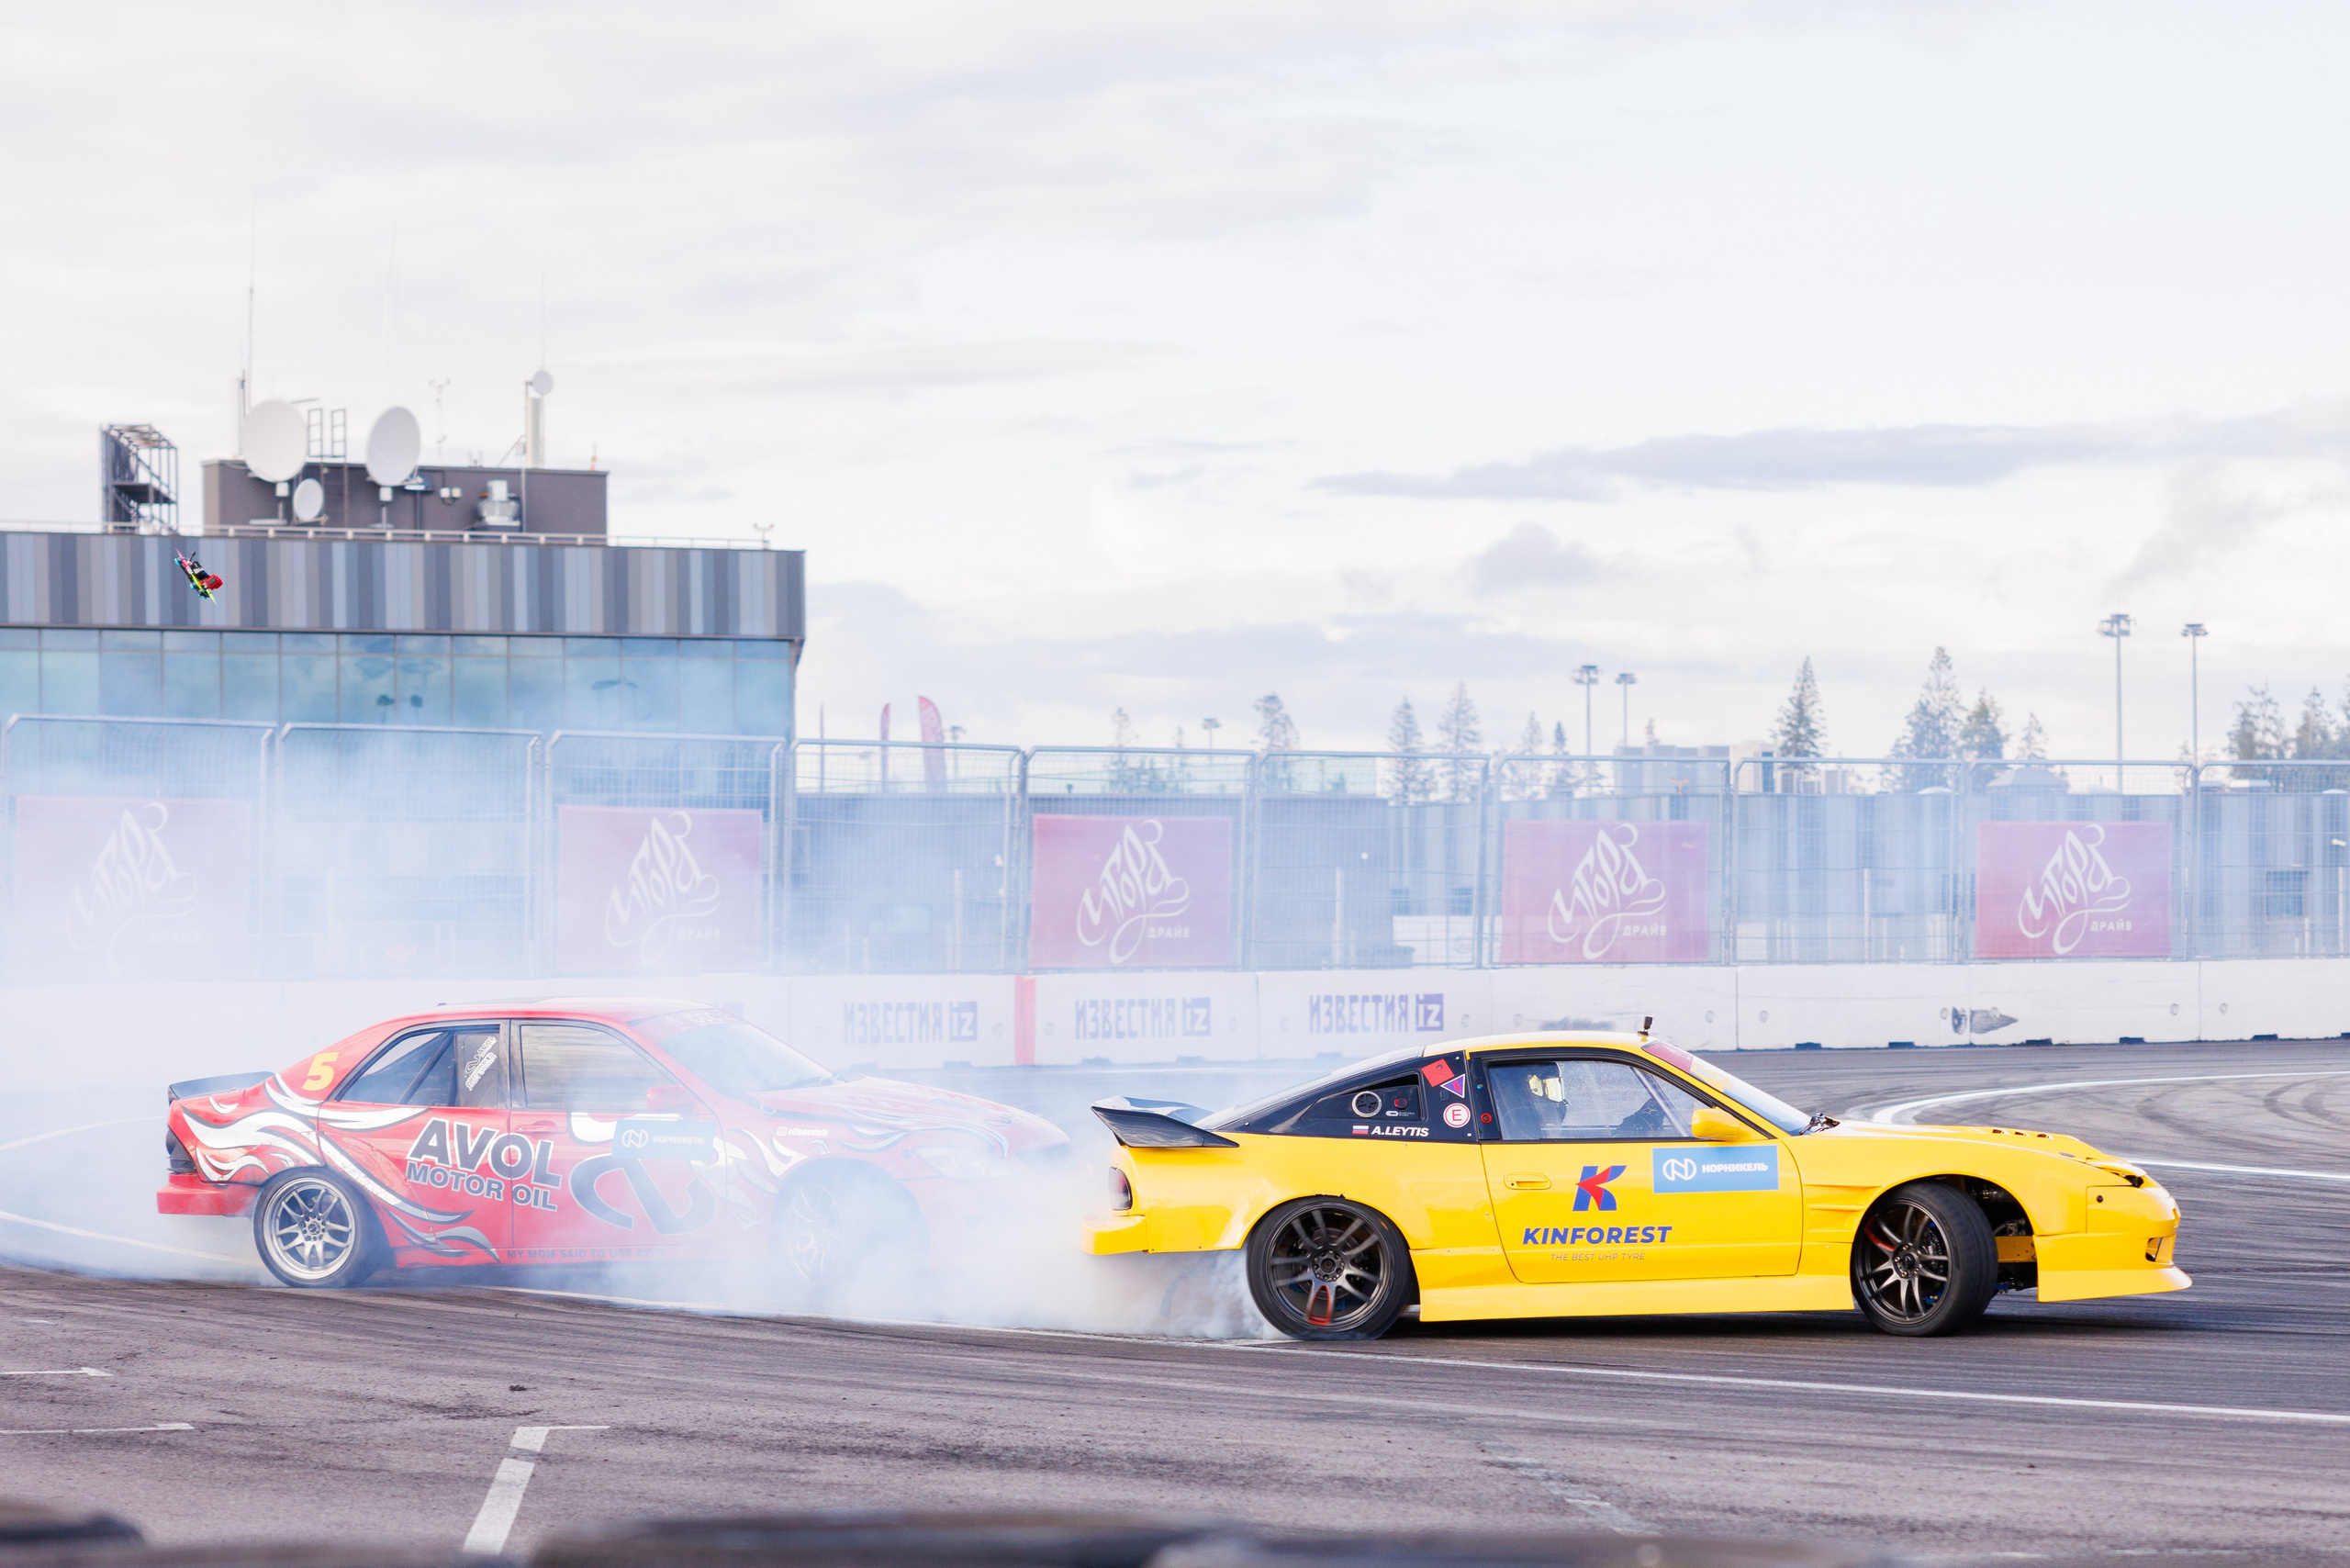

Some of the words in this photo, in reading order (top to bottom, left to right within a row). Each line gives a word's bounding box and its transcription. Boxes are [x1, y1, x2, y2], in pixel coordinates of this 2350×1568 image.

[1147, 924, 1190, 938] ДРАЙВ
[1623, 923, 1667, 936] ДРАЙВ
[2090, 919, 2132, 931] ДРАЙВ
[679, 926, 721, 940] ДРАЙВ
[1075, 998, 1176, 1039] ИЗВЕСТИЯ
[1309, 994, 1408, 1033] ИЗВЕСТИЯ
[844, 1002, 943, 1044] ИЗВЕСТИЯ
[301, 1051, 340, 1092] 5
[1451, 1109, 1462, 1122] E
[1371, 1126, 1429, 1137] A.LEYTIS
[652, 1136, 706, 1146] НОРНИКЕЛЬ
[406, 1116, 562, 1190] AVOL
[1702, 1162, 1768, 1173] НОРНИКЕЛЬ
[406, 1160, 505, 1202] MOTOR
[511, 1183, 558, 1212] OIL
[1522, 1226, 1673, 1245] KINFOREST
[507, 1249, 523, 1259] MY
[528, 1249, 556, 1259] MOM
[559, 1249, 587, 1259] SAID
[590, 1249, 606, 1258] TO
[609, 1249, 632, 1258] USE
[1550, 1253, 1569, 1261] THE
[1572, 1253, 1596, 1261] BEST
[1598, 1253, 1619, 1261] UHP
[1622, 1252, 1646, 1260] TYRE
